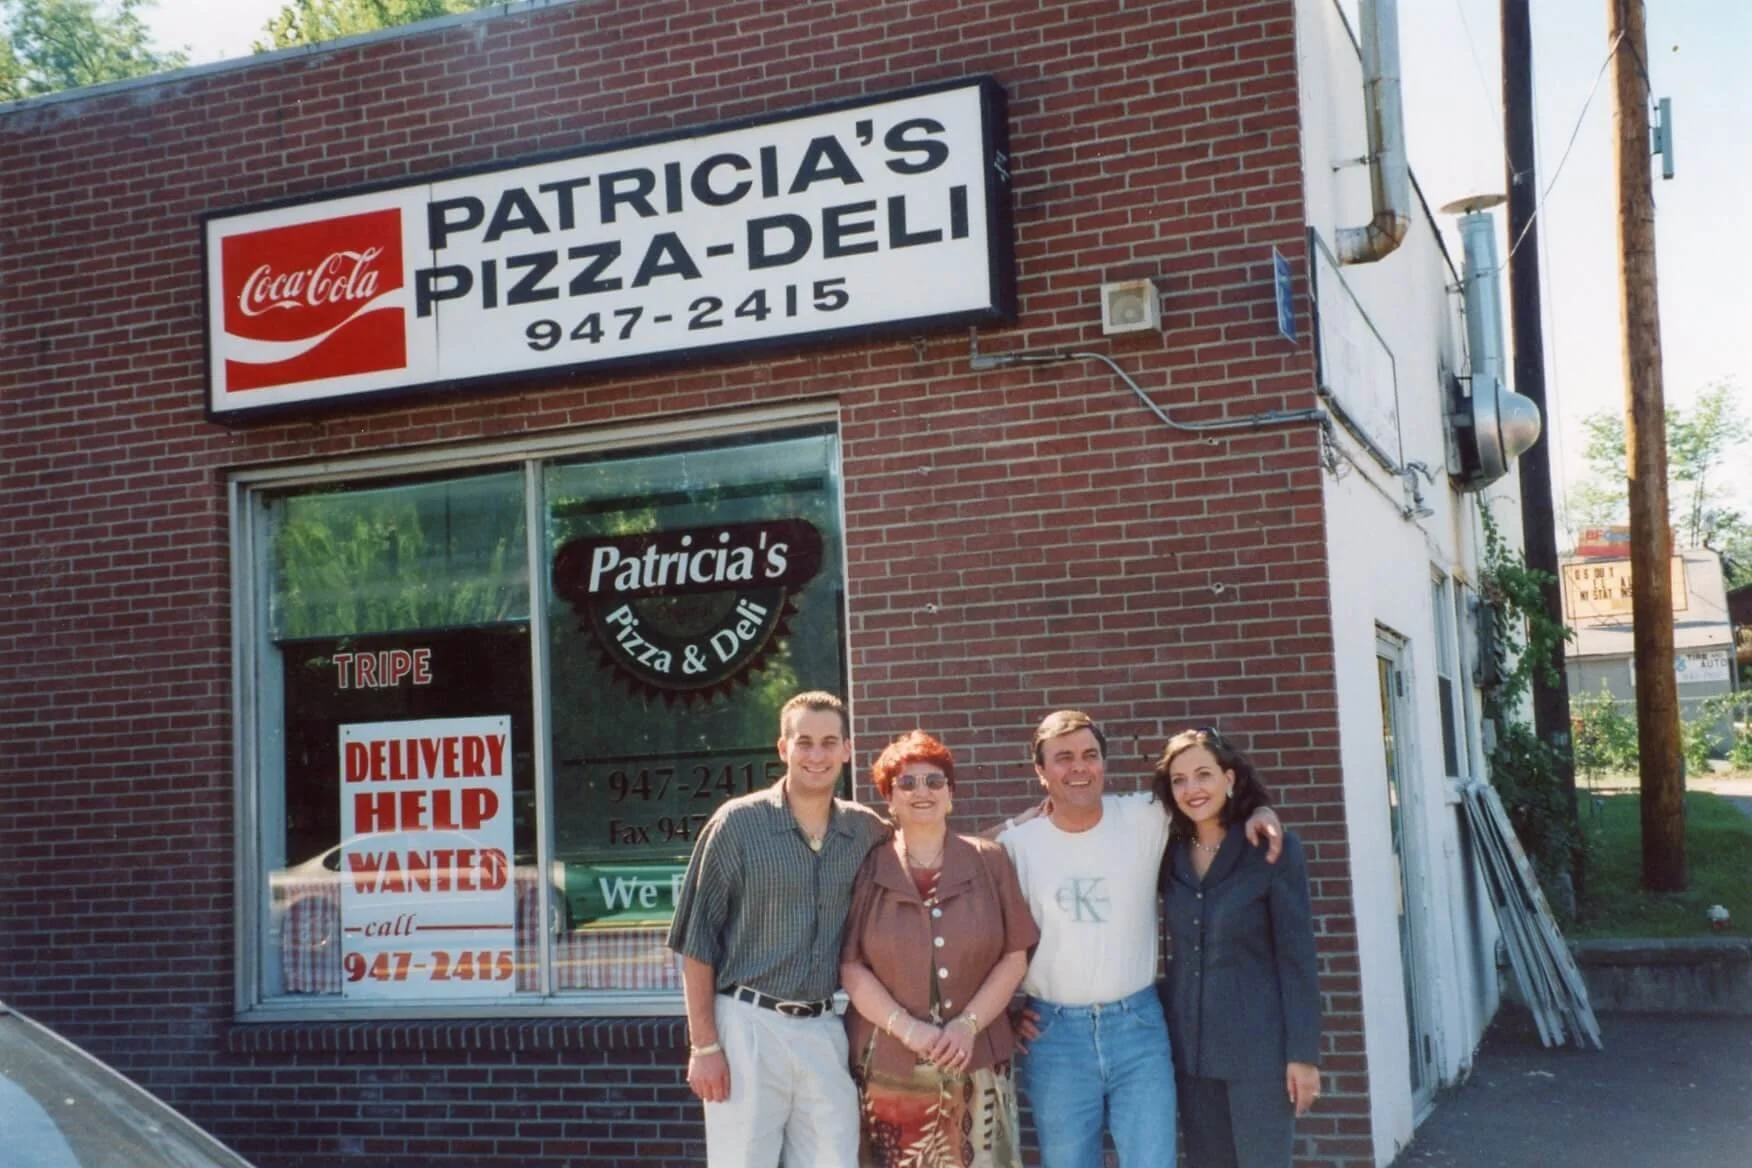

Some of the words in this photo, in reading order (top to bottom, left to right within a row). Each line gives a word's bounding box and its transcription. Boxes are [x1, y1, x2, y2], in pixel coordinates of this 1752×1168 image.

[426, 116, 950, 250] PATRICIA'S
[414, 186, 970, 319] PIZZA-DELI
[524, 276, 850, 352] 947-2415
[588, 531, 789, 593] Patricia's
[605, 603, 673, 673] Pizza
[682, 644, 708, 675] &
[710, 598, 768, 663] Deli
[333, 648, 433, 689] TRIPE
[345, 733, 506, 783] DELIVERY
[354, 787, 500, 834] HELP
[608, 819, 649, 846] Fax
[347, 848, 508, 895] WANTED
[599, 875, 658, 911] We
[364, 912, 417, 938] call
[343, 950, 515, 983] 947-2415
